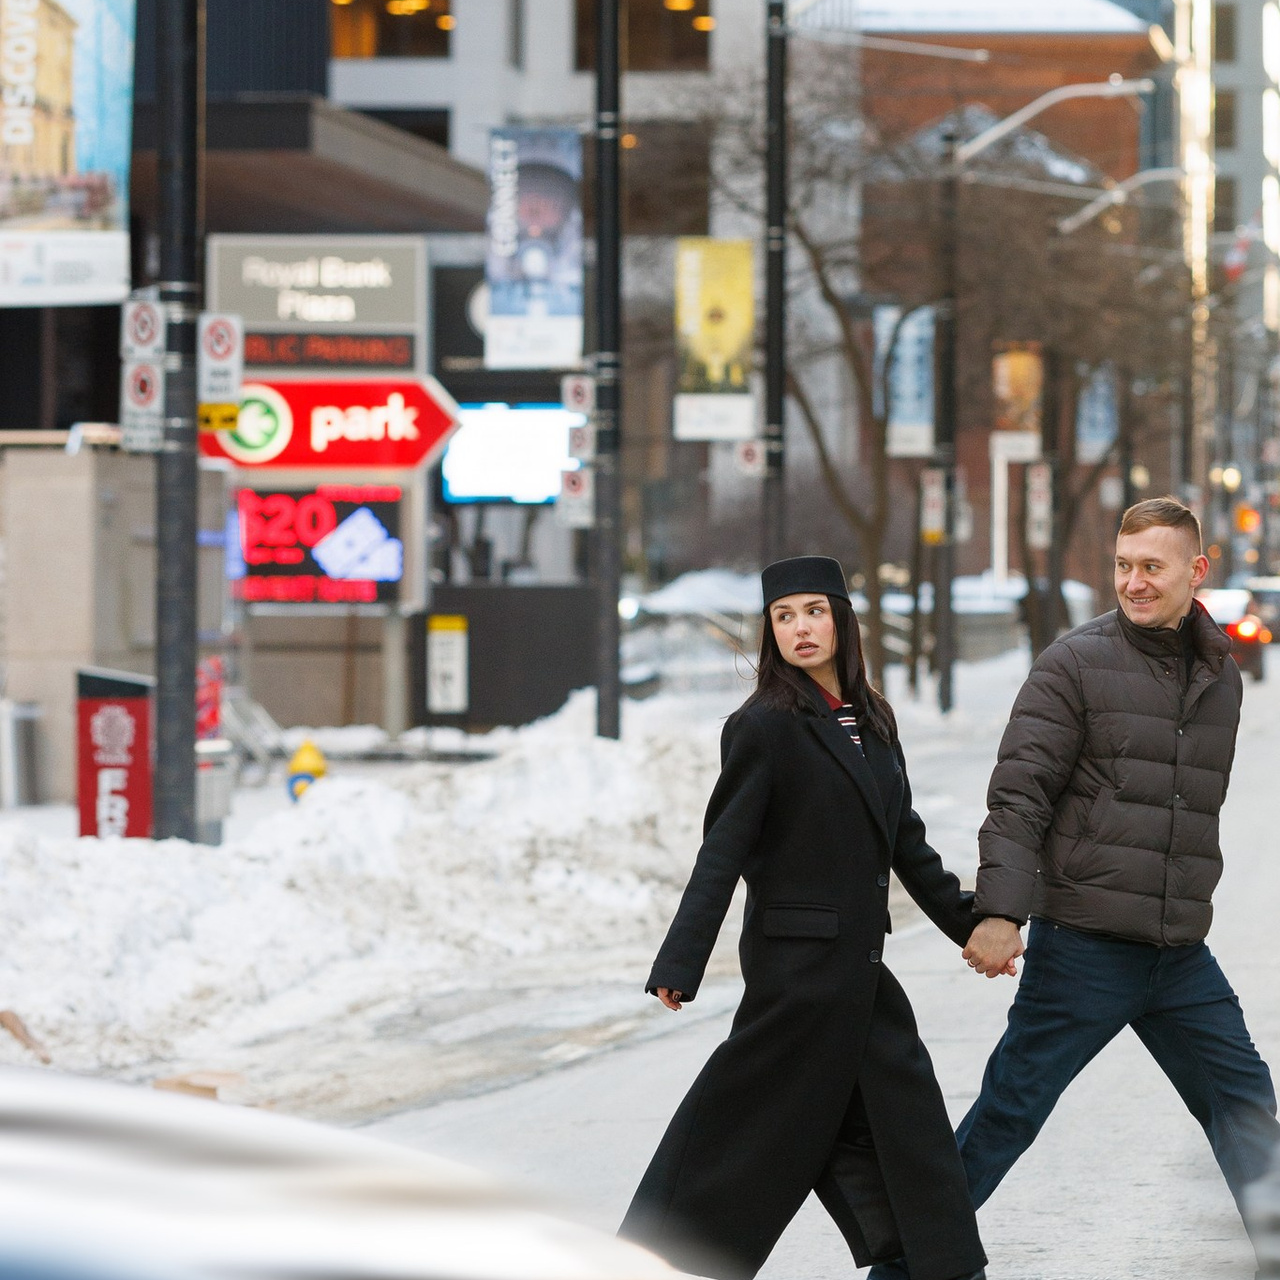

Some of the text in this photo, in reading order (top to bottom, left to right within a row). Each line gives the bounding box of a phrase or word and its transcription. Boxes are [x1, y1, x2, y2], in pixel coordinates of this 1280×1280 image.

[490, 137, 519, 257] CONNECT
[243, 256, 391, 289] Royal Bank
[278, 289, 356, 321] Plaza
[244, 334, 410, 366] BLIC PARKING
[311, 392, 420, 452] park
